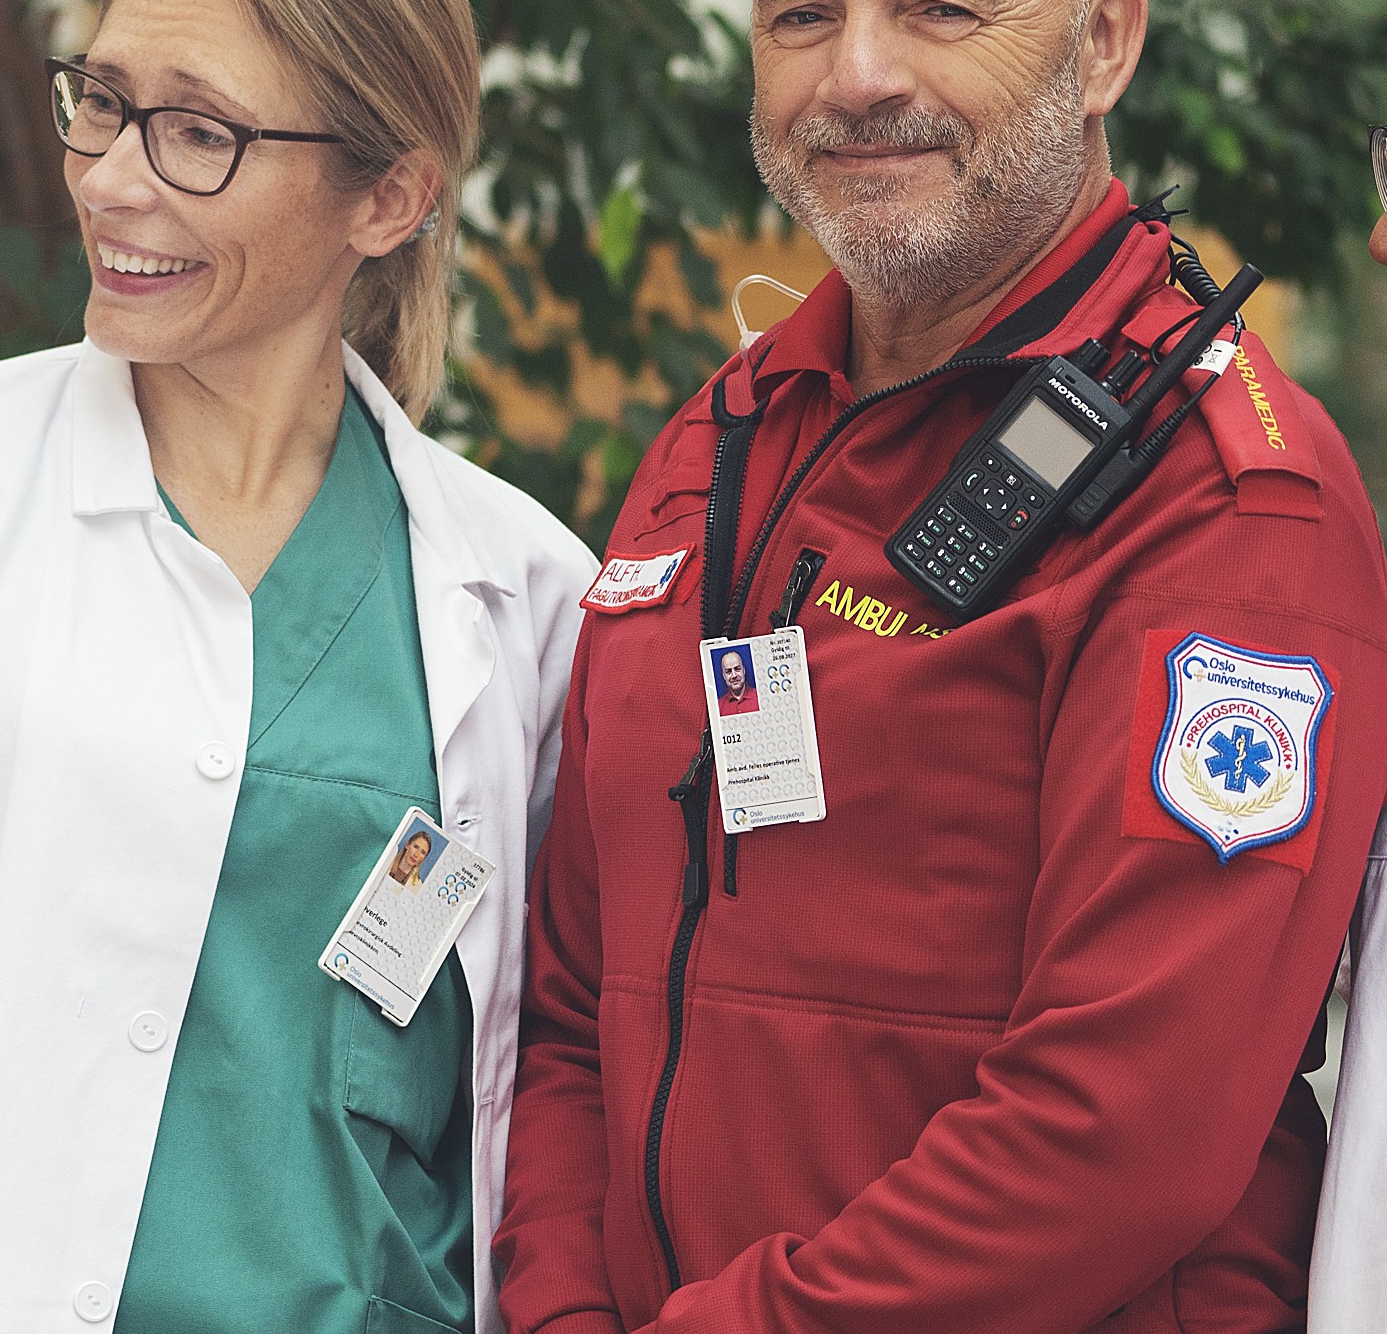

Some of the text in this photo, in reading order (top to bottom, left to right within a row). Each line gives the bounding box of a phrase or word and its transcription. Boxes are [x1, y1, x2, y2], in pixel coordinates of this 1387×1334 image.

[1048, 377, 1108, 430] MOTOROLA
[1234, 346, 1286, 450] PARAMEDIC
[1209, 657, 1236, 674] Oslo
[1207, 671, 1316, 706] universitetssykehus
[722, 734, 742, 745] 1012
[1187, 703, 1294, 763] PREHOSPITAL KLINIKK
[749, 810, 763, 818] Oslo
[750, 811, 805, 824] universitetssykehus
[356, 920, 384, 943] evrokirurgisk
[349, 965, 362, 978] Oslo
[346, 971, 395, 1010] universitetssykehus
